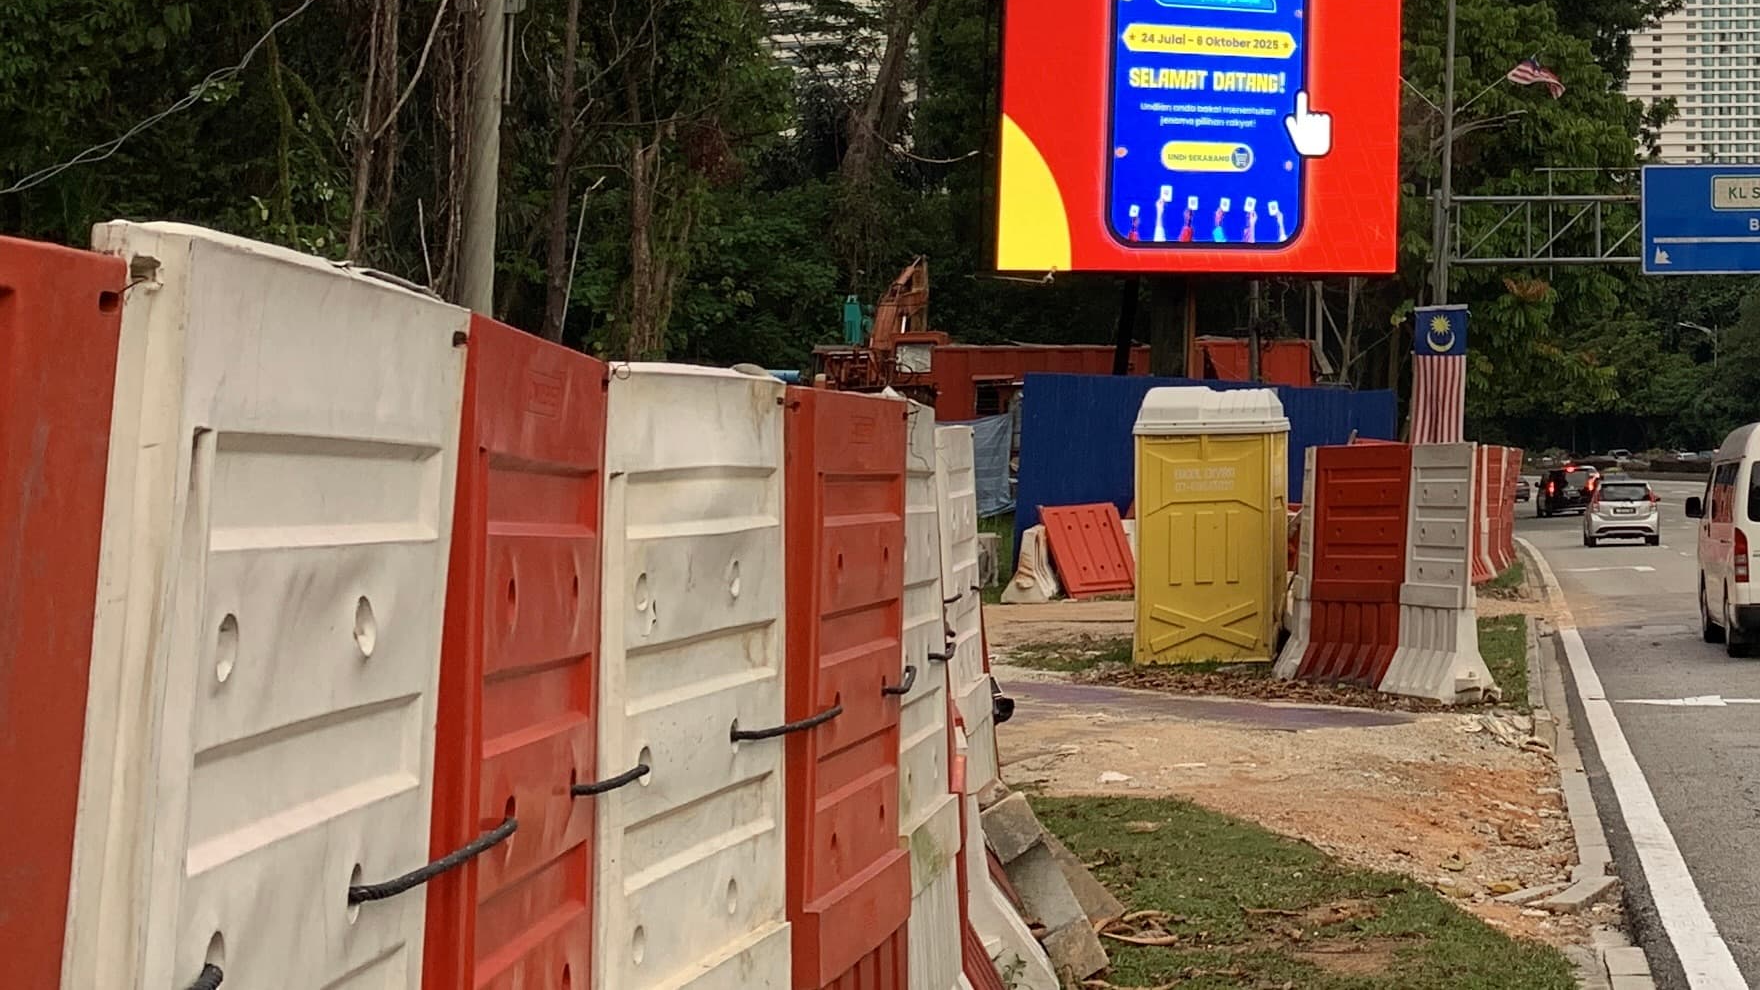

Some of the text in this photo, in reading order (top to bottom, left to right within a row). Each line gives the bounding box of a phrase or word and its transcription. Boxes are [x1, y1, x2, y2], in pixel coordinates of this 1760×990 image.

[1141, 33, 1155, 44] 24
[1157, 34, 1186, 46] Julai
[1205, 36, 1250, 49] Oktober
[1253, 39, 1279, 50] 2025
[1129, 67, 1286, 94] SELAMAT DATANG!
[1728, 187, 1747, 199] KL
